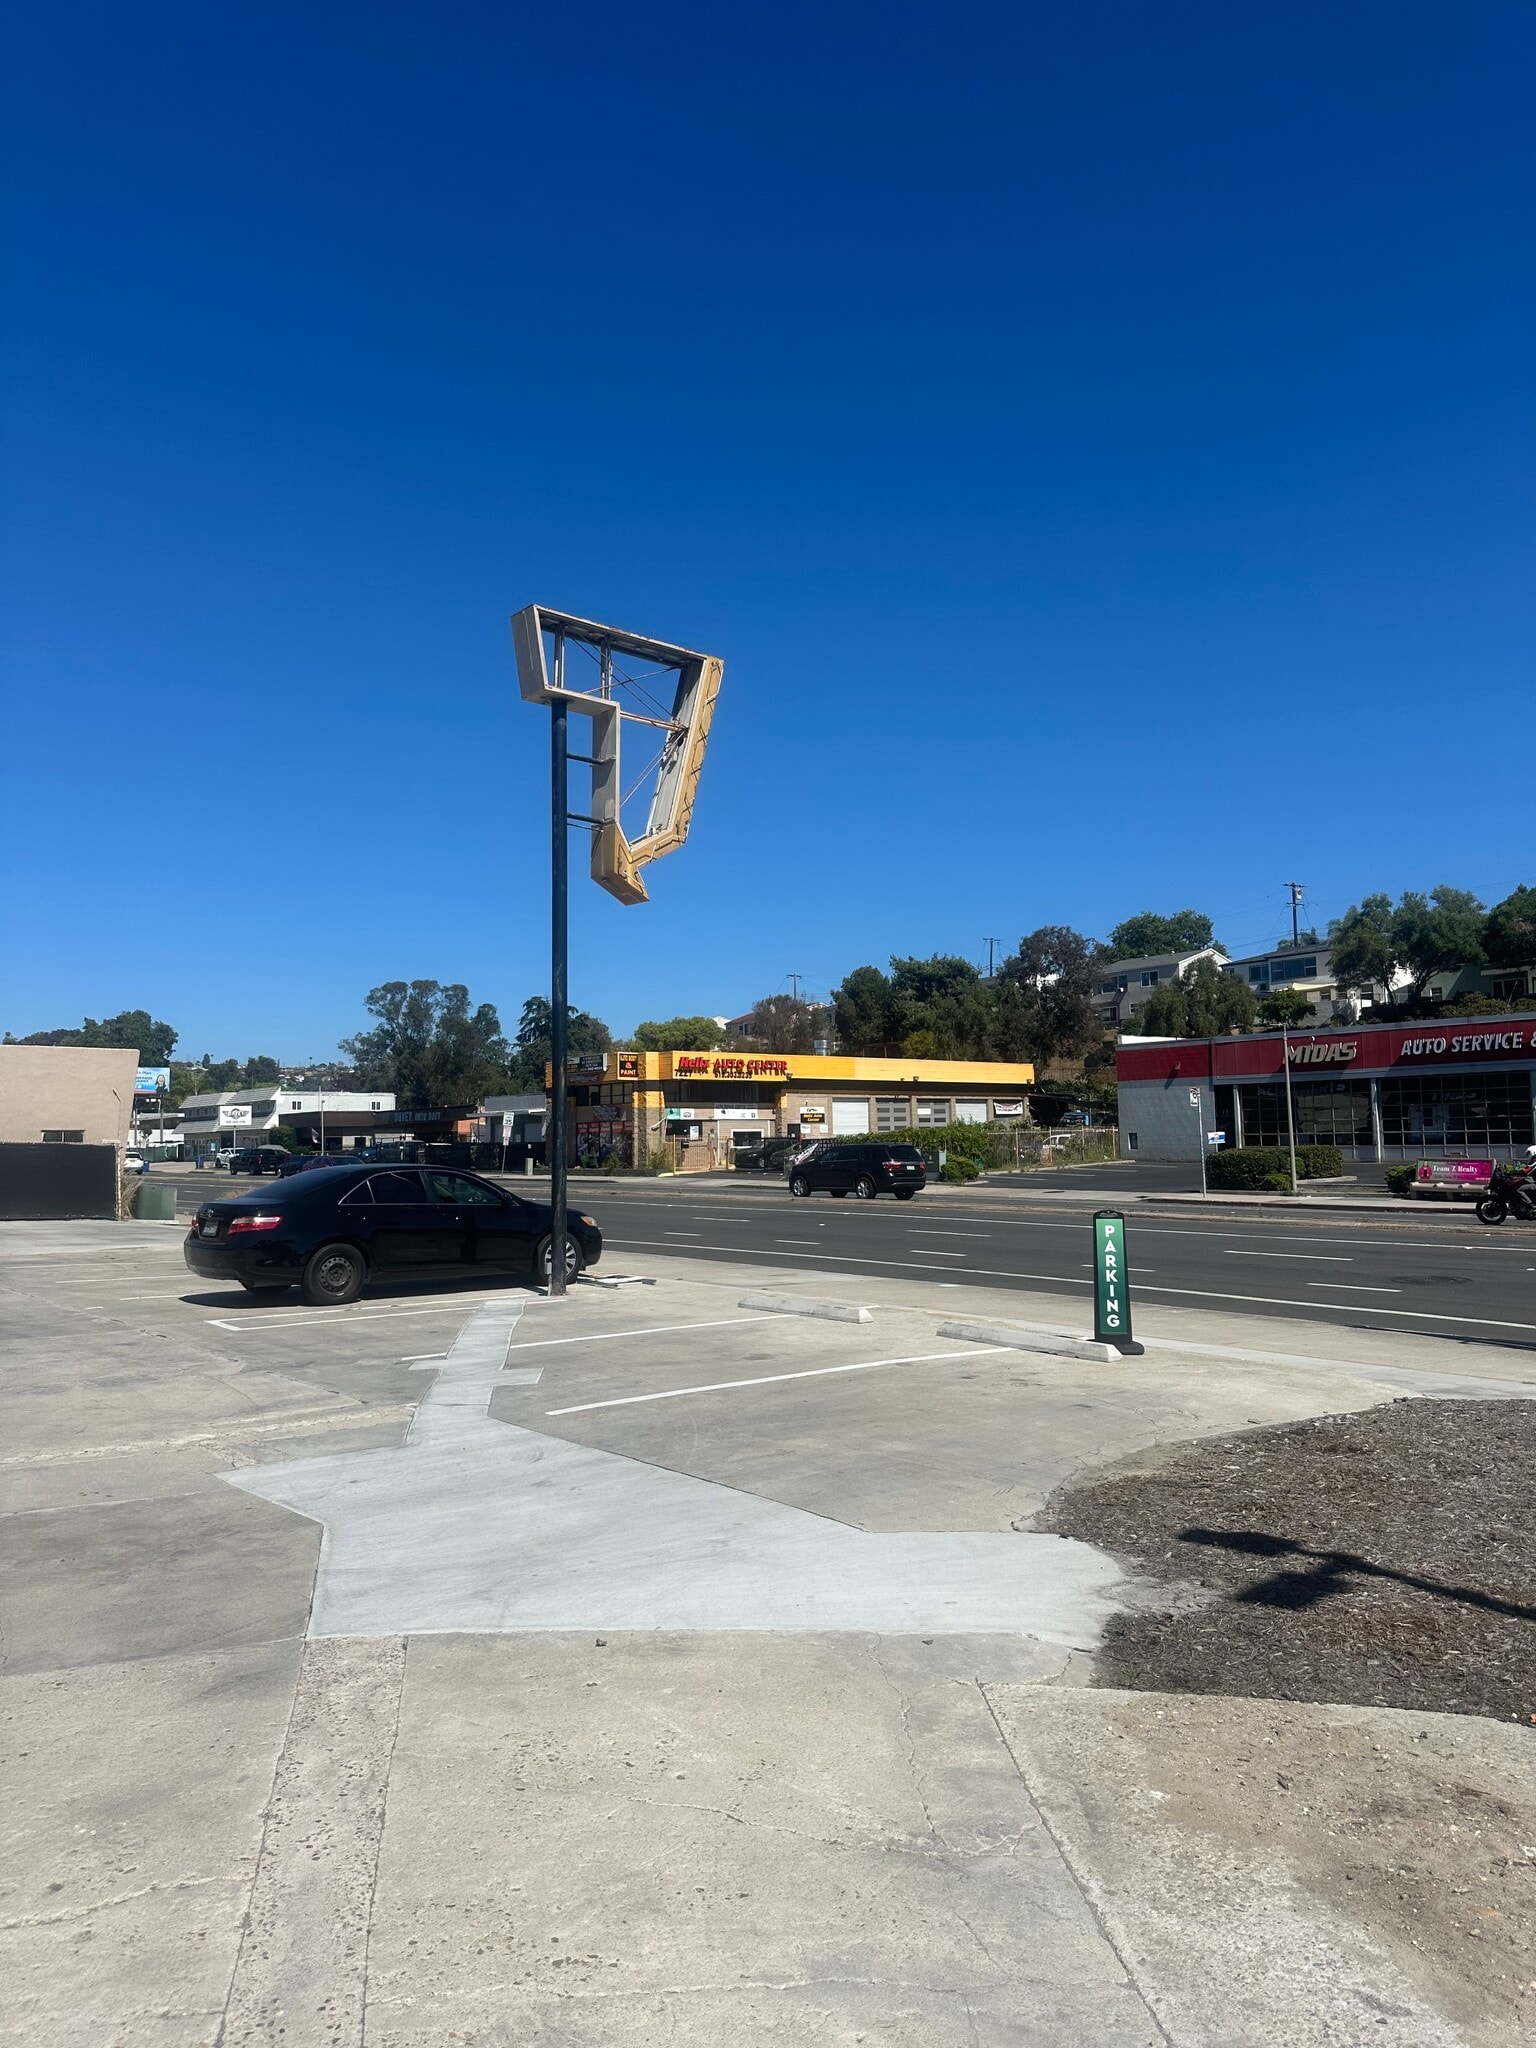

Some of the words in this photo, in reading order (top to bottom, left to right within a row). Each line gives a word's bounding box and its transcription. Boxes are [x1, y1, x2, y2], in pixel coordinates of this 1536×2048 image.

[1283, 1041, 1357, 1064] MIDAS
[1400, 1037, 1447, 1056] AUTO
[1451, 1031, 1523, 1053] SERVICE
[674, 1069, 692, 1077] 7227
[679, 1057, 711, 1069] Helix
[714, 1059, 745, 1070] AUTO
[747, 1060, 788, 1071] CENTER
[1457, 1165, 1478, 1174] Realty
[1104, 1225, 1120, 1328] PARKING
